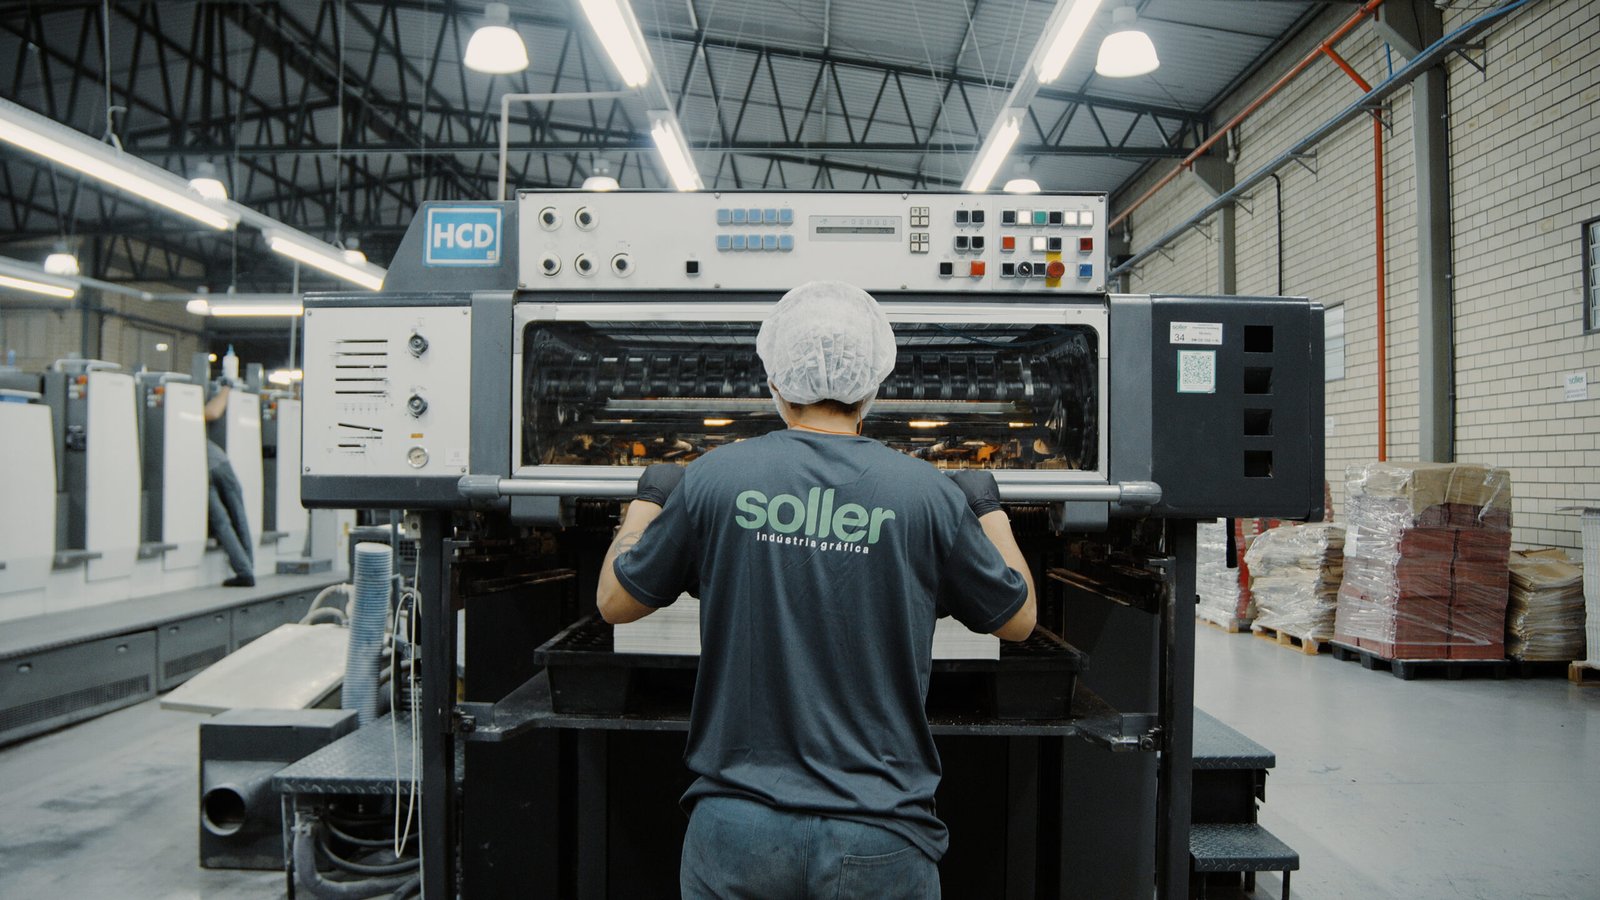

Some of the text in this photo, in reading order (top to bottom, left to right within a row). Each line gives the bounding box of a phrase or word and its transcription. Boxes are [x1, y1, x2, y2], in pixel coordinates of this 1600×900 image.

[433, 223, 494, 249] HCD
[1174, 333, 1185, 342] 34
[735, 486, 896, 544] soller
[756, 531, 869, 554] indústria gráfica
